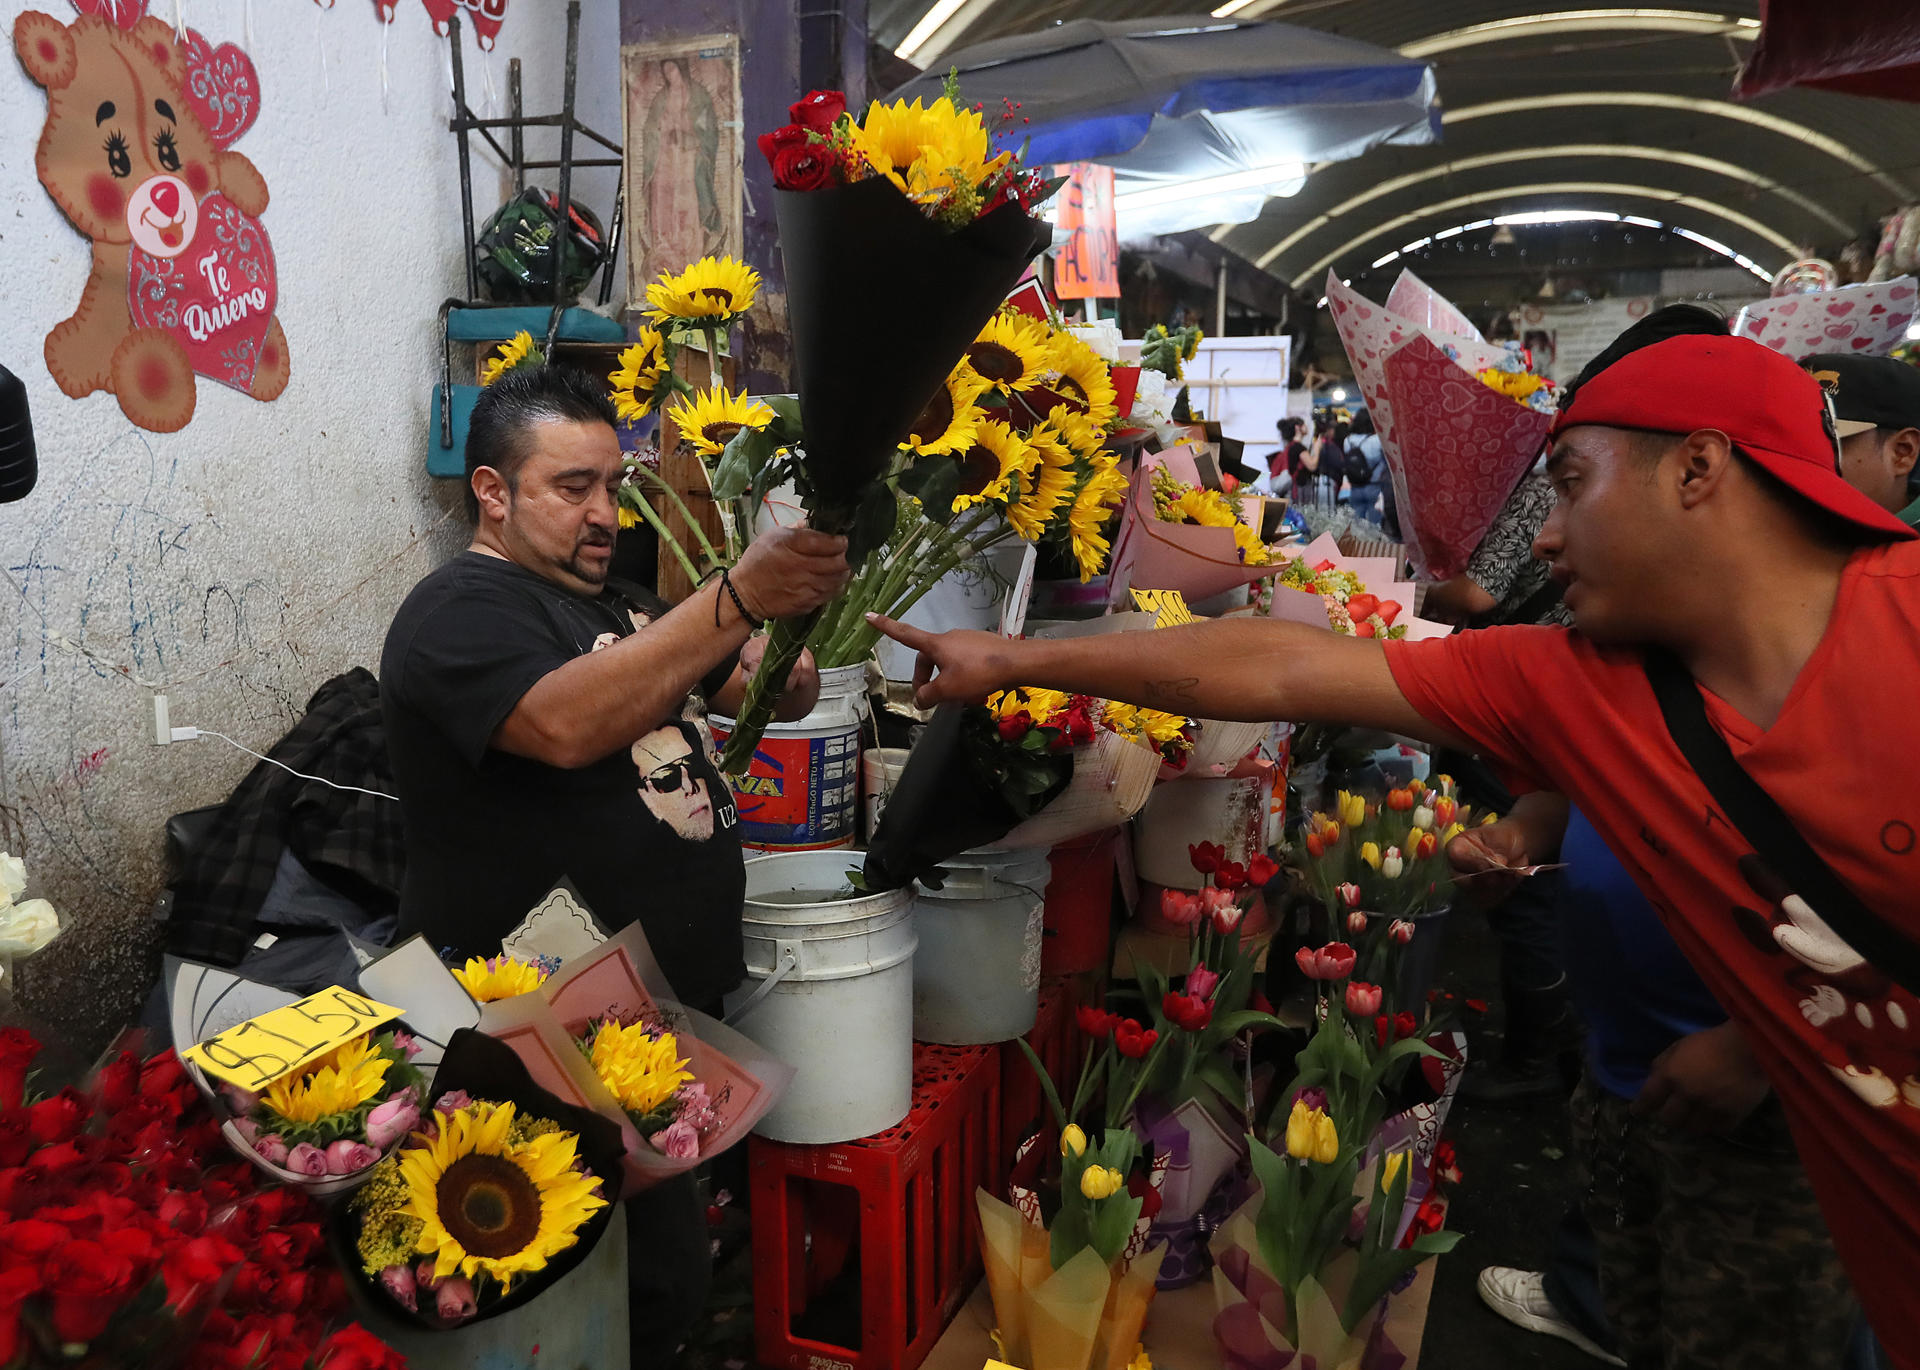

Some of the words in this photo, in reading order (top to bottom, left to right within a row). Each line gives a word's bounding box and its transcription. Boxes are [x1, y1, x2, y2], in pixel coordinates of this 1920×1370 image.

[200, 249, 231, 298] Te
[183, 287, 267, 342] Quiero
[810, 766, 818, 788] NETO
[718, 803, 737, 829] U2
[201, 991, 380, 1087] $150
